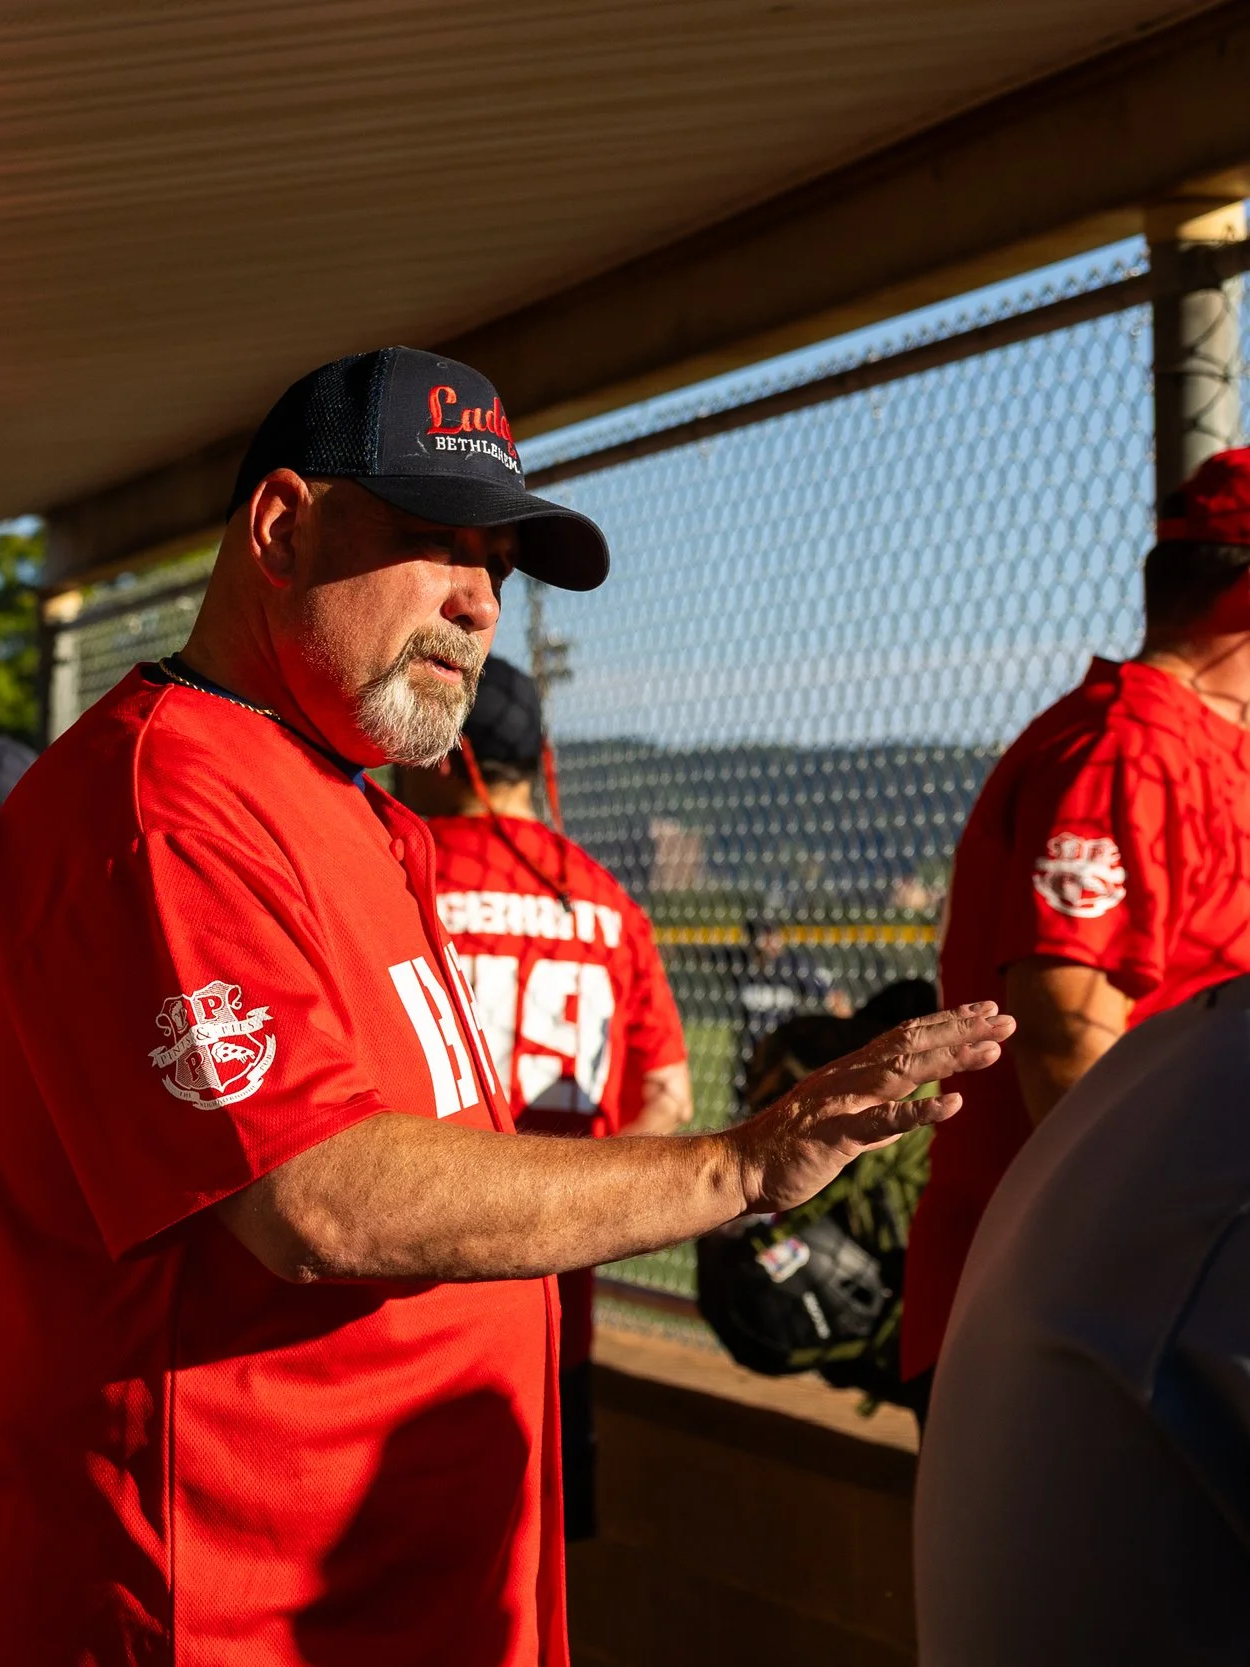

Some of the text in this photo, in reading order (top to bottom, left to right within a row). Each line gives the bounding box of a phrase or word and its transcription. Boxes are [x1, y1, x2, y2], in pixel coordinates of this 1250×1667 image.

[435, 435, 521, 474] BETHLEHEM
[200, 995, 223, 1020] P
[160, 1021, 255, 1065] PINTS & PIES
[185, 1051, 201, 1082] P
